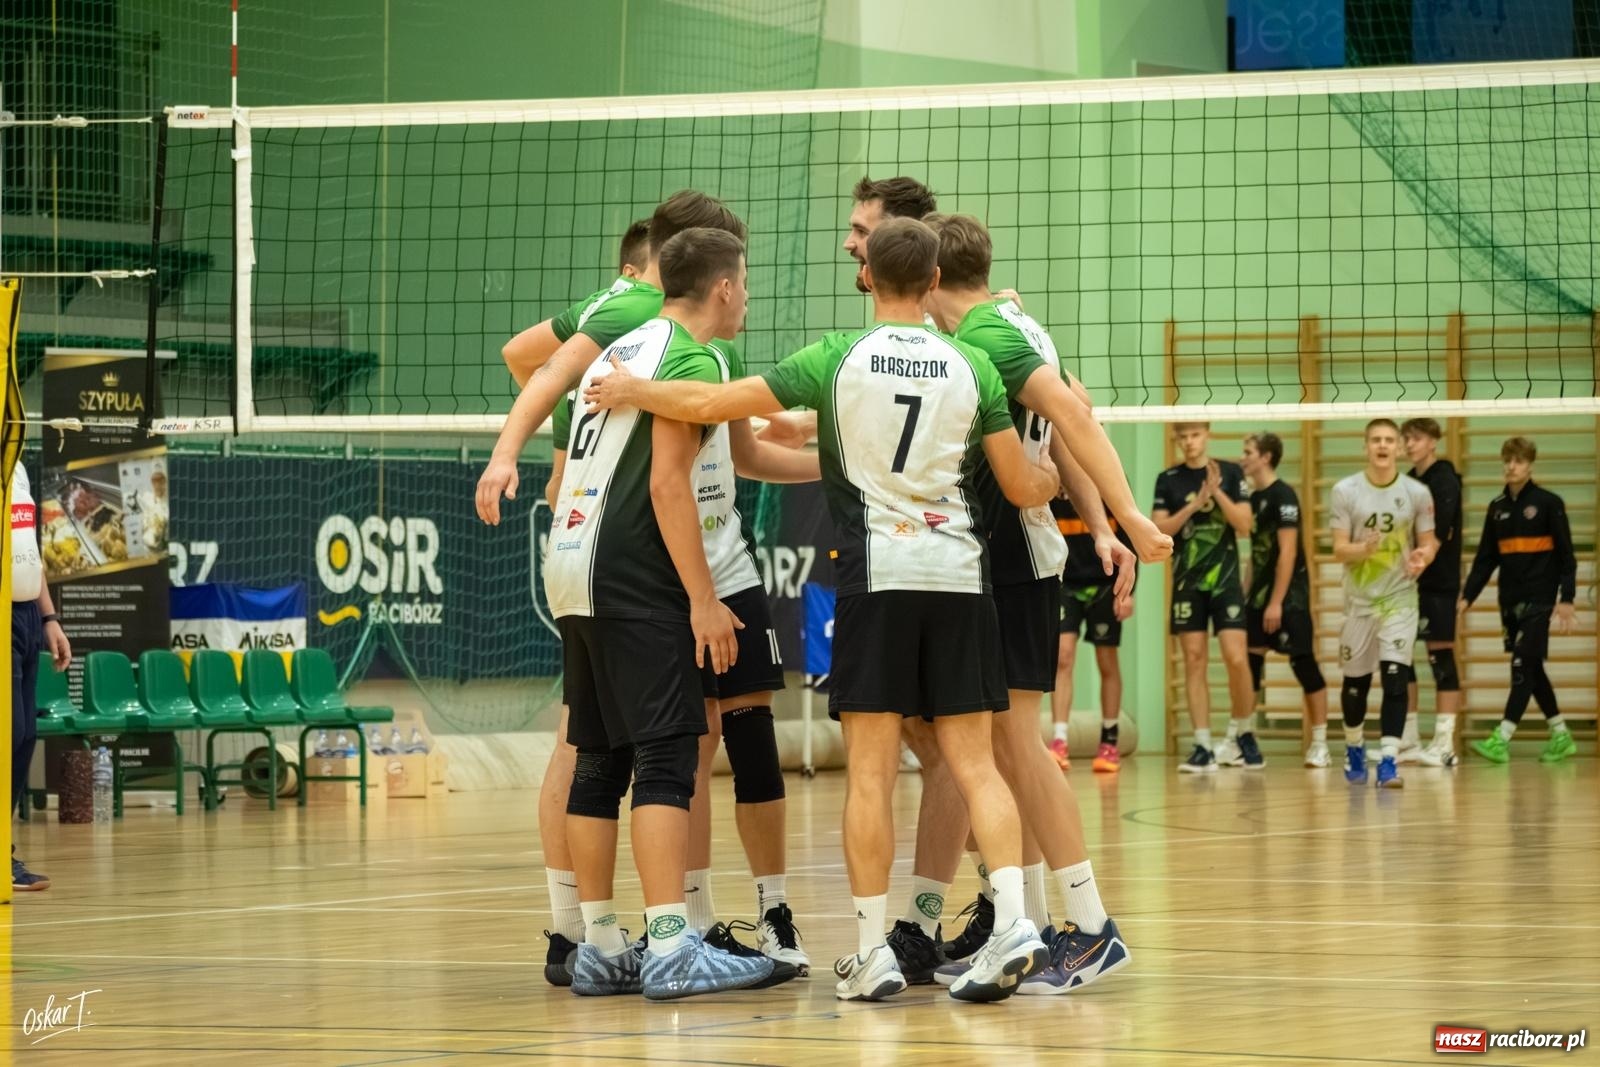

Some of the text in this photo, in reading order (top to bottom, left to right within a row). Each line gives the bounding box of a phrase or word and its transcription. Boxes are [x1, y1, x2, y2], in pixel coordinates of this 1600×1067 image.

[177, 112, 206, 120] netex
[871, 354, 948, 379] BŁASZCZOK
[160, 419, 222, 431] netex KSR
[891, 394, 922, 473] 7
[1364, 512, 1395, 533] 43
[368, 597, 443, 624] RACIBÓRZ
[1174, 602, 1192, 619] 15
